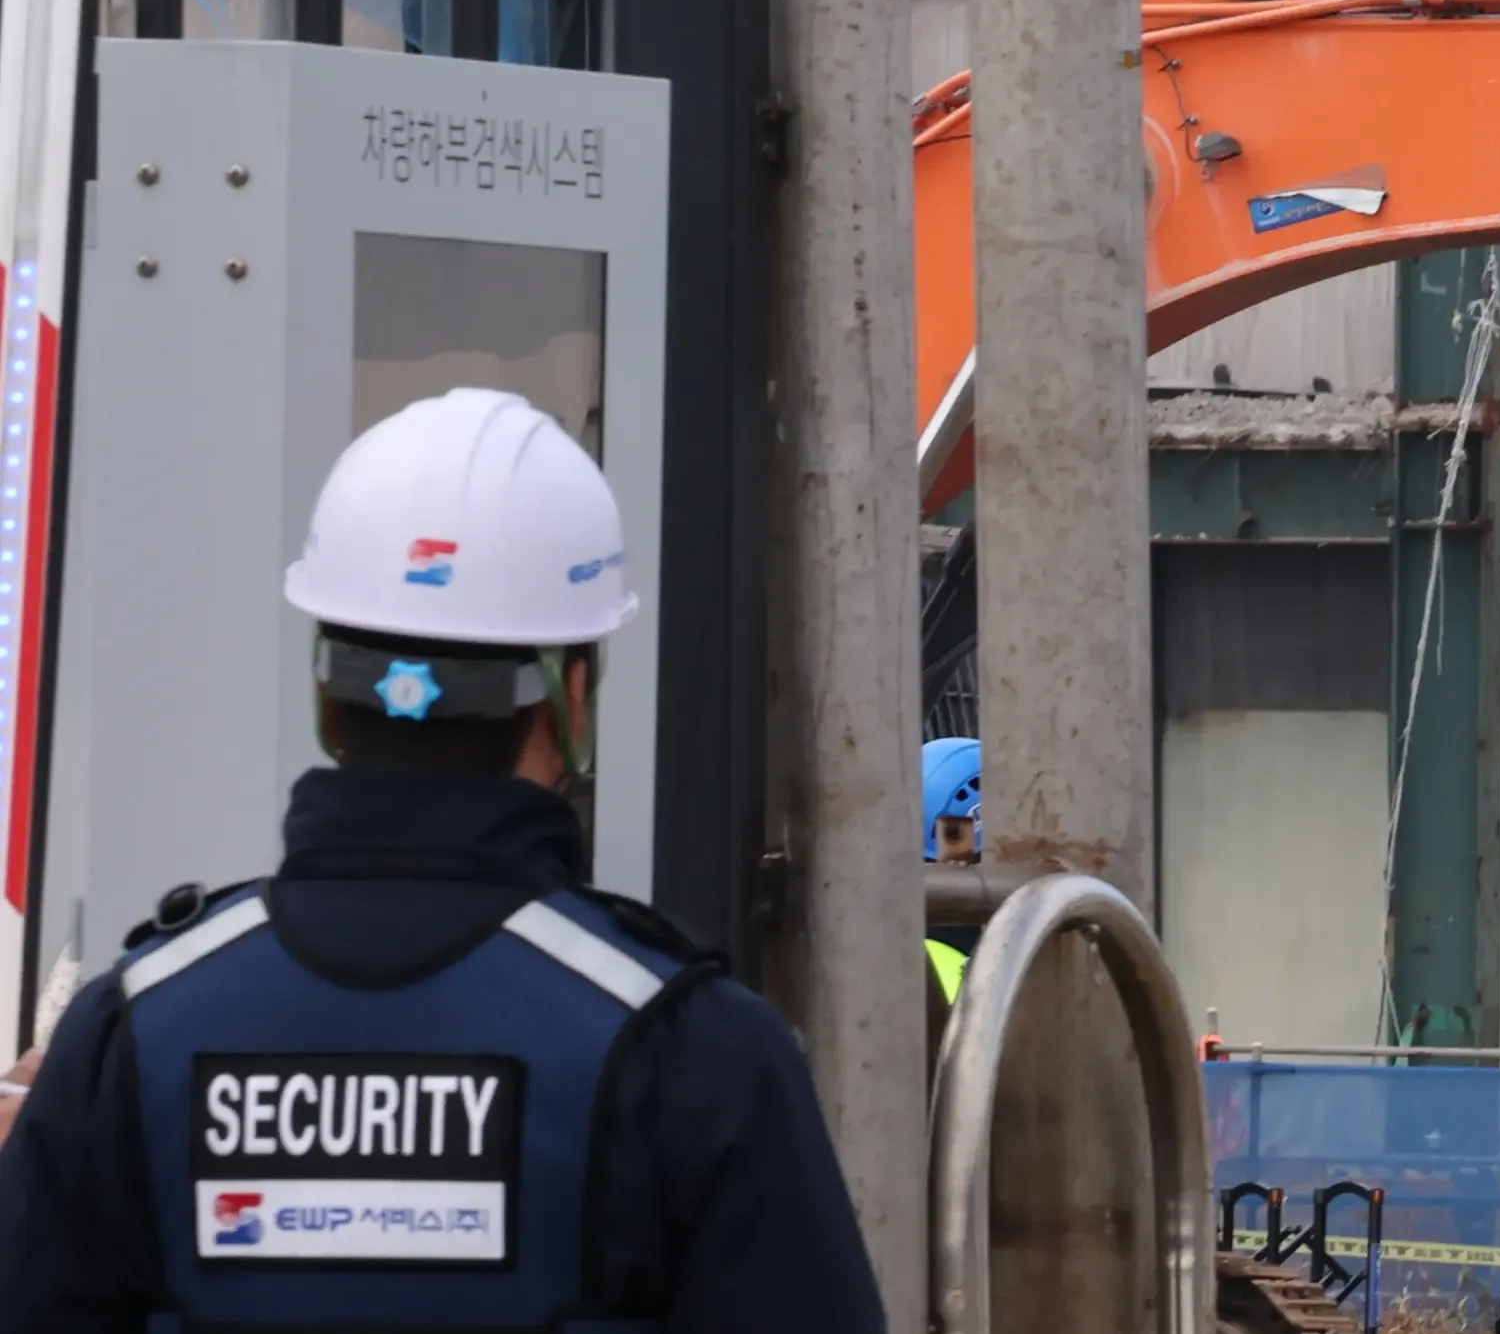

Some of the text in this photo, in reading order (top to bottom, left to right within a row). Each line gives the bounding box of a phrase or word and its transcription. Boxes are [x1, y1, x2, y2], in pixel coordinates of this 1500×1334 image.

[361, 105, 605, 199] 차량하부검색시스템
[205, 1072, 499, 1157] SECURITY
[274, 1206, 353, 1232] EWP
